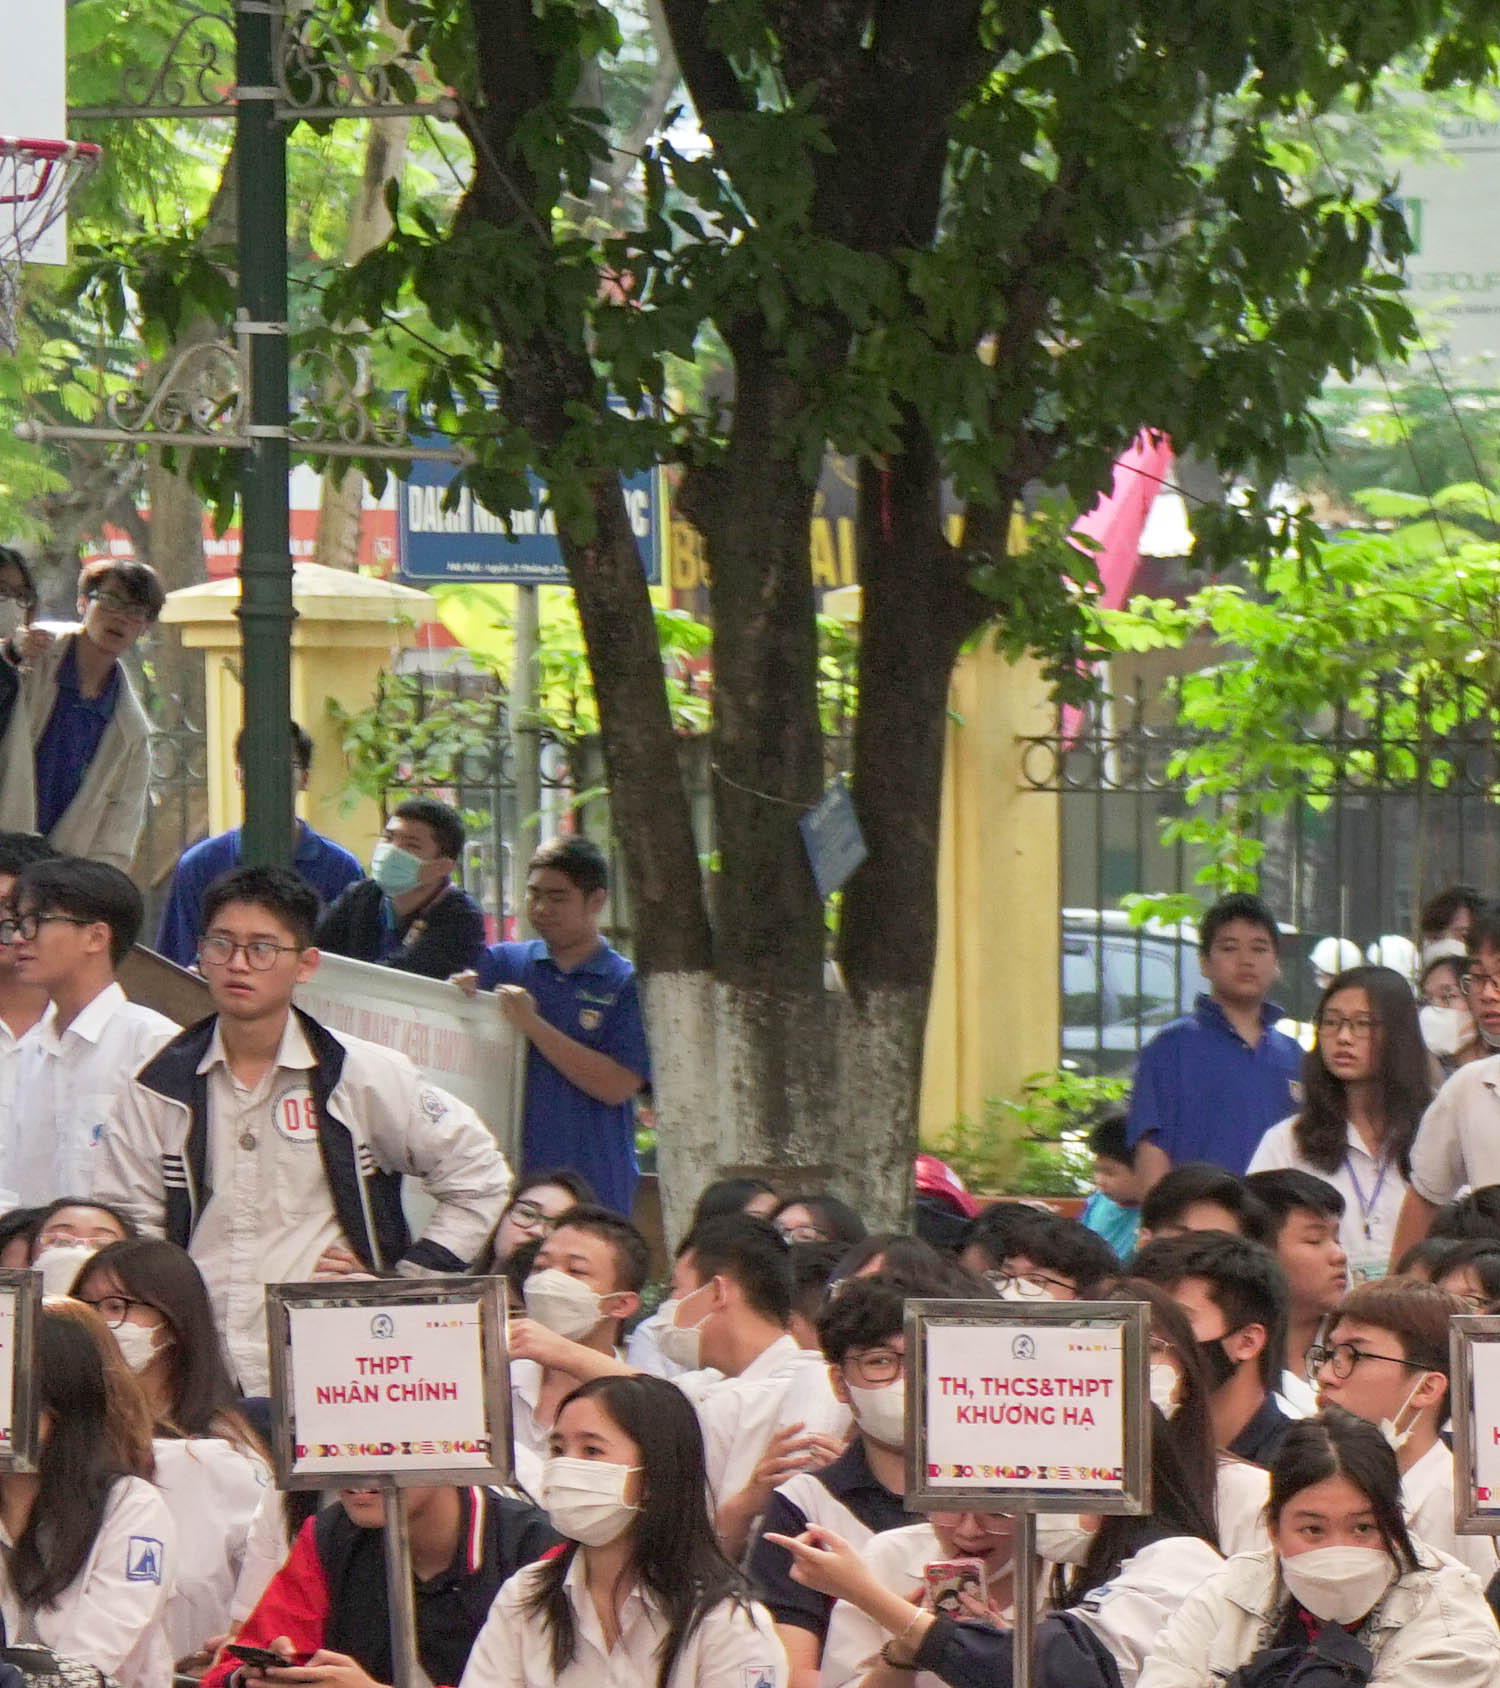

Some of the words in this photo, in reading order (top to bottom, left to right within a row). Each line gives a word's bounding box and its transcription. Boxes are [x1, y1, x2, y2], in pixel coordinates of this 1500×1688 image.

[355, 1355, 413, 1375] THPT
[316, 1380, 379, 1404] NHÂN
[385, 1378, 458, 1402] CHÍNH
[938, 1376, 975, 1399] TH,
[980, 1378, 1113, 1398] THCS&THPT
[956, 1403, 1056, 1426] KHƯƠNG
[1062, 1407, 1096, 1431] HẠ
